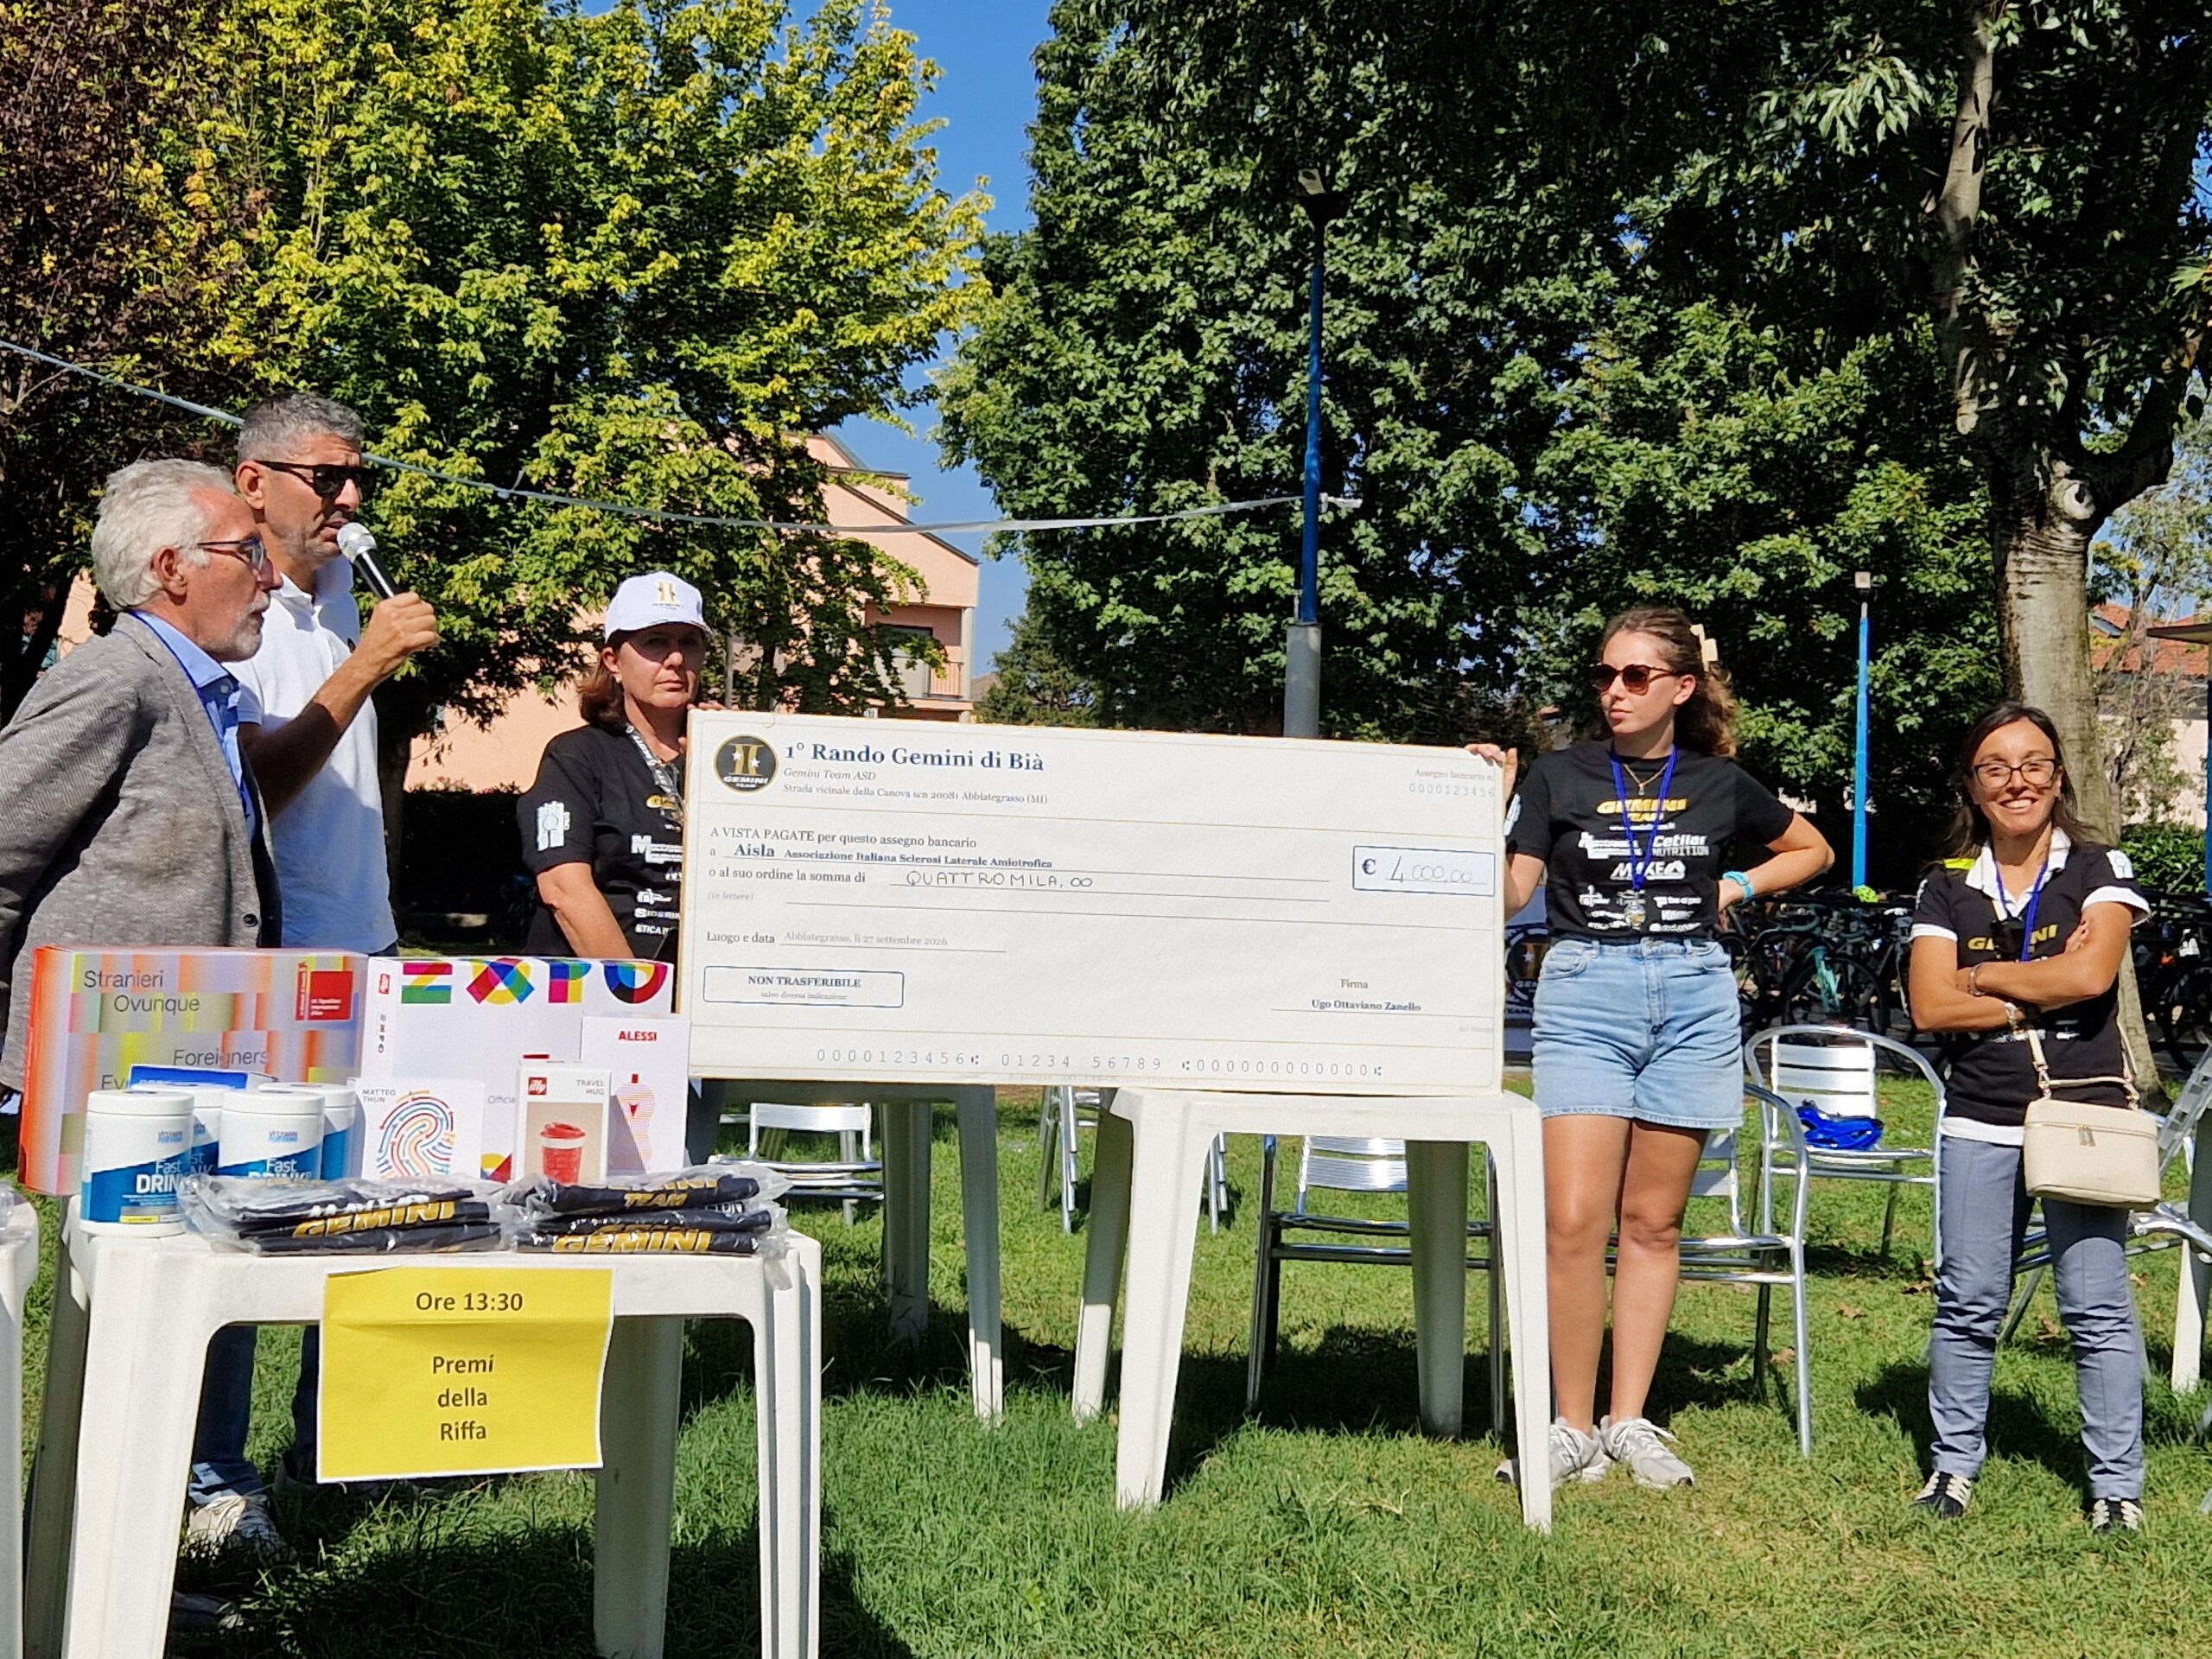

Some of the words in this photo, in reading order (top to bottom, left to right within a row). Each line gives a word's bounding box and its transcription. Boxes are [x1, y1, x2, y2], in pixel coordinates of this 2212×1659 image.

[811, 743, 885, 764] Rando
[892, 747, 974, 767] Gemini
[981, 750, 1001, 768] di
[1008, 753, 1045, 772] Bià
[784, 767, 820, 778] Gemini
[823, 769, 851, 779] Team
[853, 771, 876, 780] ASD
[1414, 768, 1448, 779] Assegno
[1450, 770, 1485, 780] bancario
[783, 784, 813, 793] Strada
[816, 785, 850, 795] vicinale
[853, 786, 874, 796] della
[877, 788, 910, 798] Canova
[962, 791, 1025, 804] Abbiategrasso
[1027, 794, 1048, 804] (MI)
[1409, 783, 1495, 798] 0000123456
[710, 827, 719, 836] A
[722, 827, 760, 839] VISTA
[764, 829, 815, 842] PAGATE
[817, 833, 836, 844] per
[839, 834, 877, 846] questo
[880, 836, 925, 849] assegno
[927, 836, 977, 848] bancario
[734, 843, 775, 858] Aisla
[784, 849, 854, 861] Associazione
[856, 851, 897, 862] Italiana
[899, 854, 941, 864] Sclerosi
[944, 855, 988, 866] Laterale
[990, 857, 1052, 868] Amiotrofica
[709, 868, 715, 877] o
[719, 867, 729, 878] al
[733, 869, 753, 879] suo
[756, 868, 793, 880] ordine
[797, 869, 806, 880] la
[809, 873, 851, 882] somma
[855, 871, 866, 883] di
[1362, 858, 1376, 875] €
[707, 931, 740, 944] Luogo
[743, 934, 749, 943] e
[752, 931, 775, 944] data
[784, 931, 852, 944] Abbiategrasso,
[863, 937, 874, 945] 27
[875, 935, 922, 945] settembre
[924, 937, 948, 946] 2026
[84, 969, 164, 989] Stranieri
[748, 975, 774, 985] NON
[777, 976, 861, 988] TRASFERIBILE
[1340, 978, 1369, 988] Firma
[114, 994, 200, 1016] Ovunque
[1312, 999, 1332, 1010] Ugo
[1333, 1000, 1382, 1010] Ottaviano
[1384, 1002, 1421, 1011] Zanello
[618, 1031, 657, 1042] ALESSI
[174, 1048, 269, 1070] Foreigners
[529, 1079, 546, 1094] illy
[156, 1160, 181, 1174] Fast
[266, 1158, 297, 1173] Fast
[624, 1192, 688, 1208] TEAM
[292, 1200, 457, 1238] GEMINI
[551, 1230, 714, 1253] GEMINI
[416, 1292, 455, 1311] Ore
[464, 1293, 524, 1312] 13:30
[433, 1354, 494, 1375] Premi
[437, 1387, 487, 1408] della
[440, 1421, 486, 1441] Riffa
